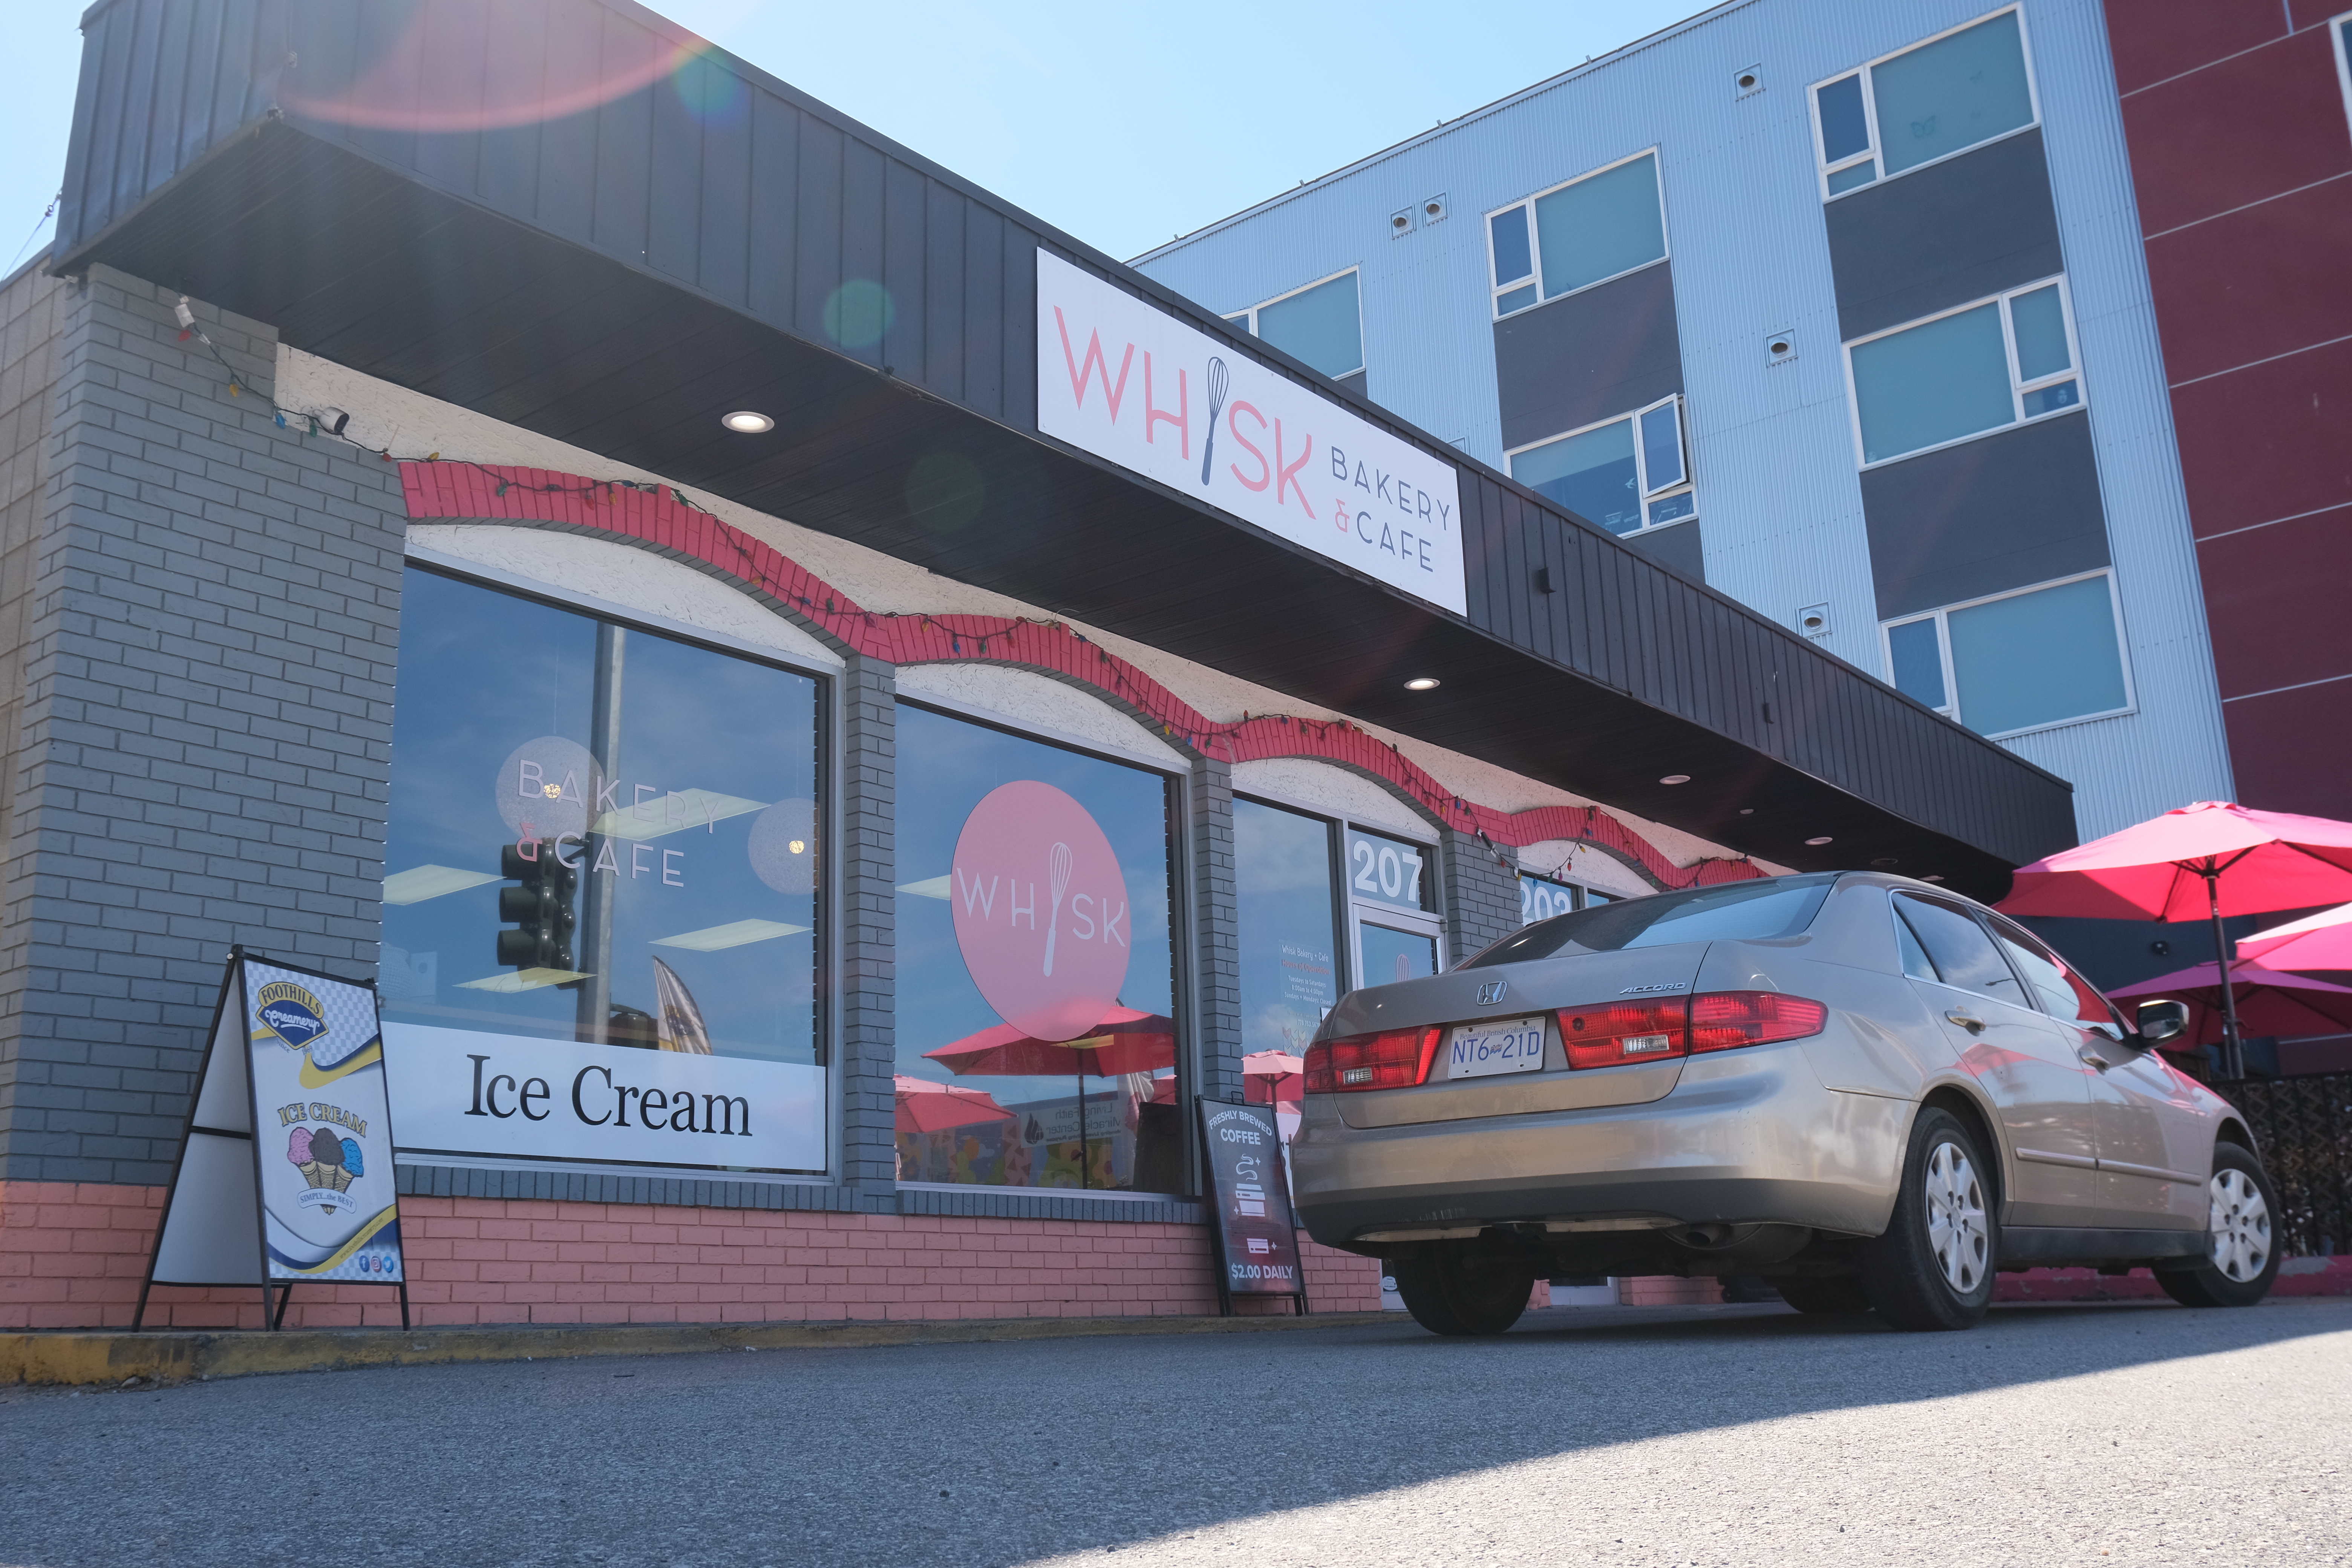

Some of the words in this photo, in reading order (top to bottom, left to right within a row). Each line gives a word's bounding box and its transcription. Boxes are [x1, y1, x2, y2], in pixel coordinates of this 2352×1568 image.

[1331, 446, 1450, 531] BAKERY
[1357, 511, 1433, 573] CAFE
[518, 759, 720, 834] BAKERY
[554, 831, 685, 887] CAFE
[1353, 840, 1423, 902] 207
[1282, 945, 1295, 956] Whisk
[1297, 948, 1313, 961] Bakery
[1318, 952, 1328, 962] Cafe
[1282, 959, 1297, 969] Hours
[1298, 963, 1303, 971] of
[1305, 964, 1330, 975] Operation
[1288, 975, 1304, 984] Tuesdays
[1309, 979, 1326, 988] Saturdays
[1620, 983, 1687, 994] ACCORD
[261, 984, 321, 1015] FOOTHILLS
[1284, 992, 1299, 1000] Sundays
[265, 1009, 320, 1035] Creamery
[1460, 1031, 1485, 1040] Beautiful
[1487, 1028, 1505, 1037] British
[1507, 1025, 1536, 1034] Columbia
[276, 1037, 290, 1053] Since
[302, 1045, 313, 1055] 1969
[1453, 1037, 1489, 1064] NT6
[1502, 1031, 1540, 1058] 21D
[464, 1054, 551, 1121] Ice
[572, 1065, 753, 1137] Cream
[277, 1102, 307, 1127] ICE
[309, 1102, 367, 1138] CREAM
[1208, 1110, 1237, 1130] FRESHLY
[1239, 1111, 1272, 1136] BREWED
[1220, 1128, 1261, 1145] COFFEE
[338, 1196, 354, 1208] BEST
[1231, 1263, 1261, 1280] $2.00
[1263, 1265, 1293, 1279] DAILY
